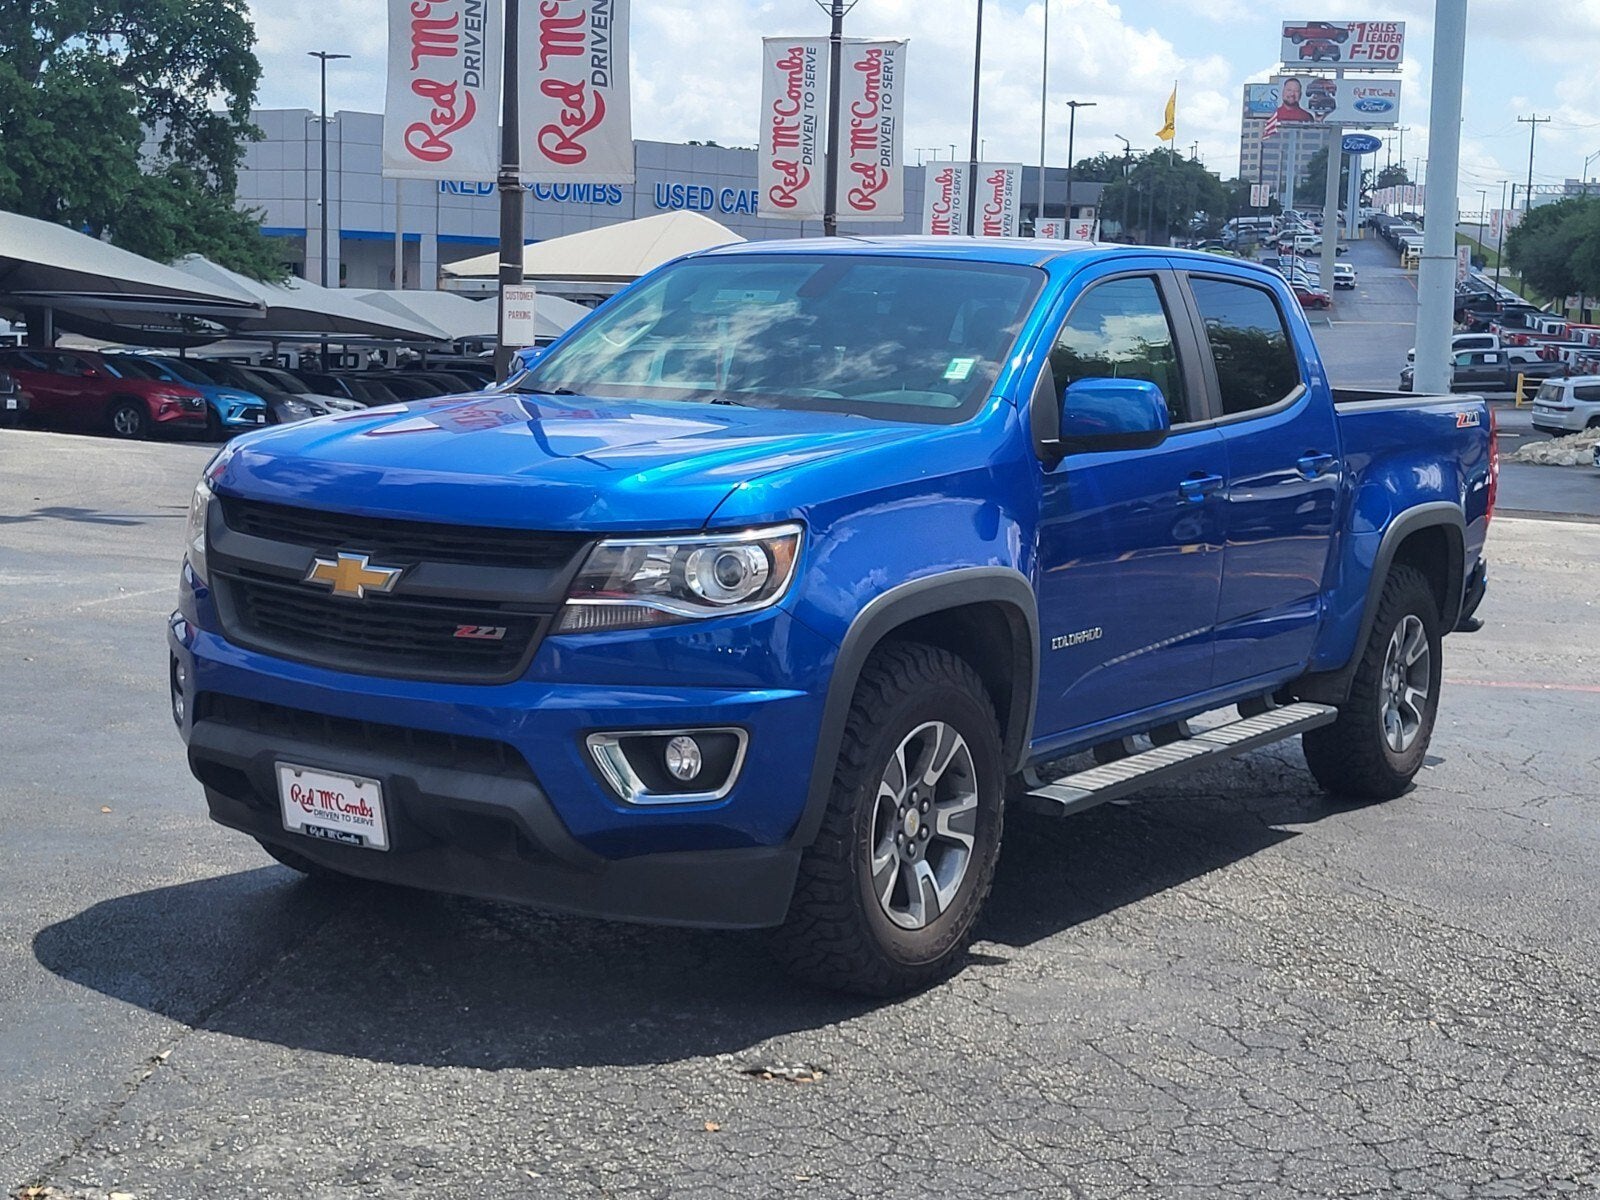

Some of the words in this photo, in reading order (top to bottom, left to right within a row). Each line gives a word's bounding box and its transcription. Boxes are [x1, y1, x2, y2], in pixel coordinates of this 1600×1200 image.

[410, 0, 459, 70] Mc
[539, 0, 586, 71] Mc
[1366, 33, 1402, 43] LEADER
[1368, 23, 1397, 33] SALES
[463, 0, 482, 88] DRIVEN
[591, 0, 608, 87] DRIVEN
[1349, 44, 1400, 60] F-150
[805, 47, 817, 88] SERVE
[883, 49, 895, 89] SERVE
[771, 46, 804, 155] McCombs
[804, 92, 815, 110] TO
[850, 48, 882, 158] McCombs
[882, 93, 893, 112] TO
[1360, 101, 1386, 111] Ford
[404, 79, 476, 162] Red
[537, 79, 605, 164] Red
[803, 115, 815, 165] DRIVEN
[880, 116, 892, 168] DRIVEN
[1343, 137, 1372, 149] Ford
[769, 160, 810, 208] Red
[848, 162, 888, 211] Red
[953, 168, 962, 195] SERVE
[1005, 169, 1014, 196] SERVE
[656, 183, 714, 210] USED
[953, 197, 960, 210] TO
[1004, 199, 1012, 210] TO
[505, 291, 534, 300] CUSTOMER
[508, 311, 531, 320] PARKING
[1456, 411, 1480, 428] Z71
[453, 625, 507, 640] Z71
[1051, 627, 1103, 650] COLORADO
[291, 783, 316, 813] Red
[316, 789, 374, 818] McCombs
[313, 808, 340, 821] DRIVEN
[341, 814, 352, 823] TO
[353, 816, 375, 827] SERVE
